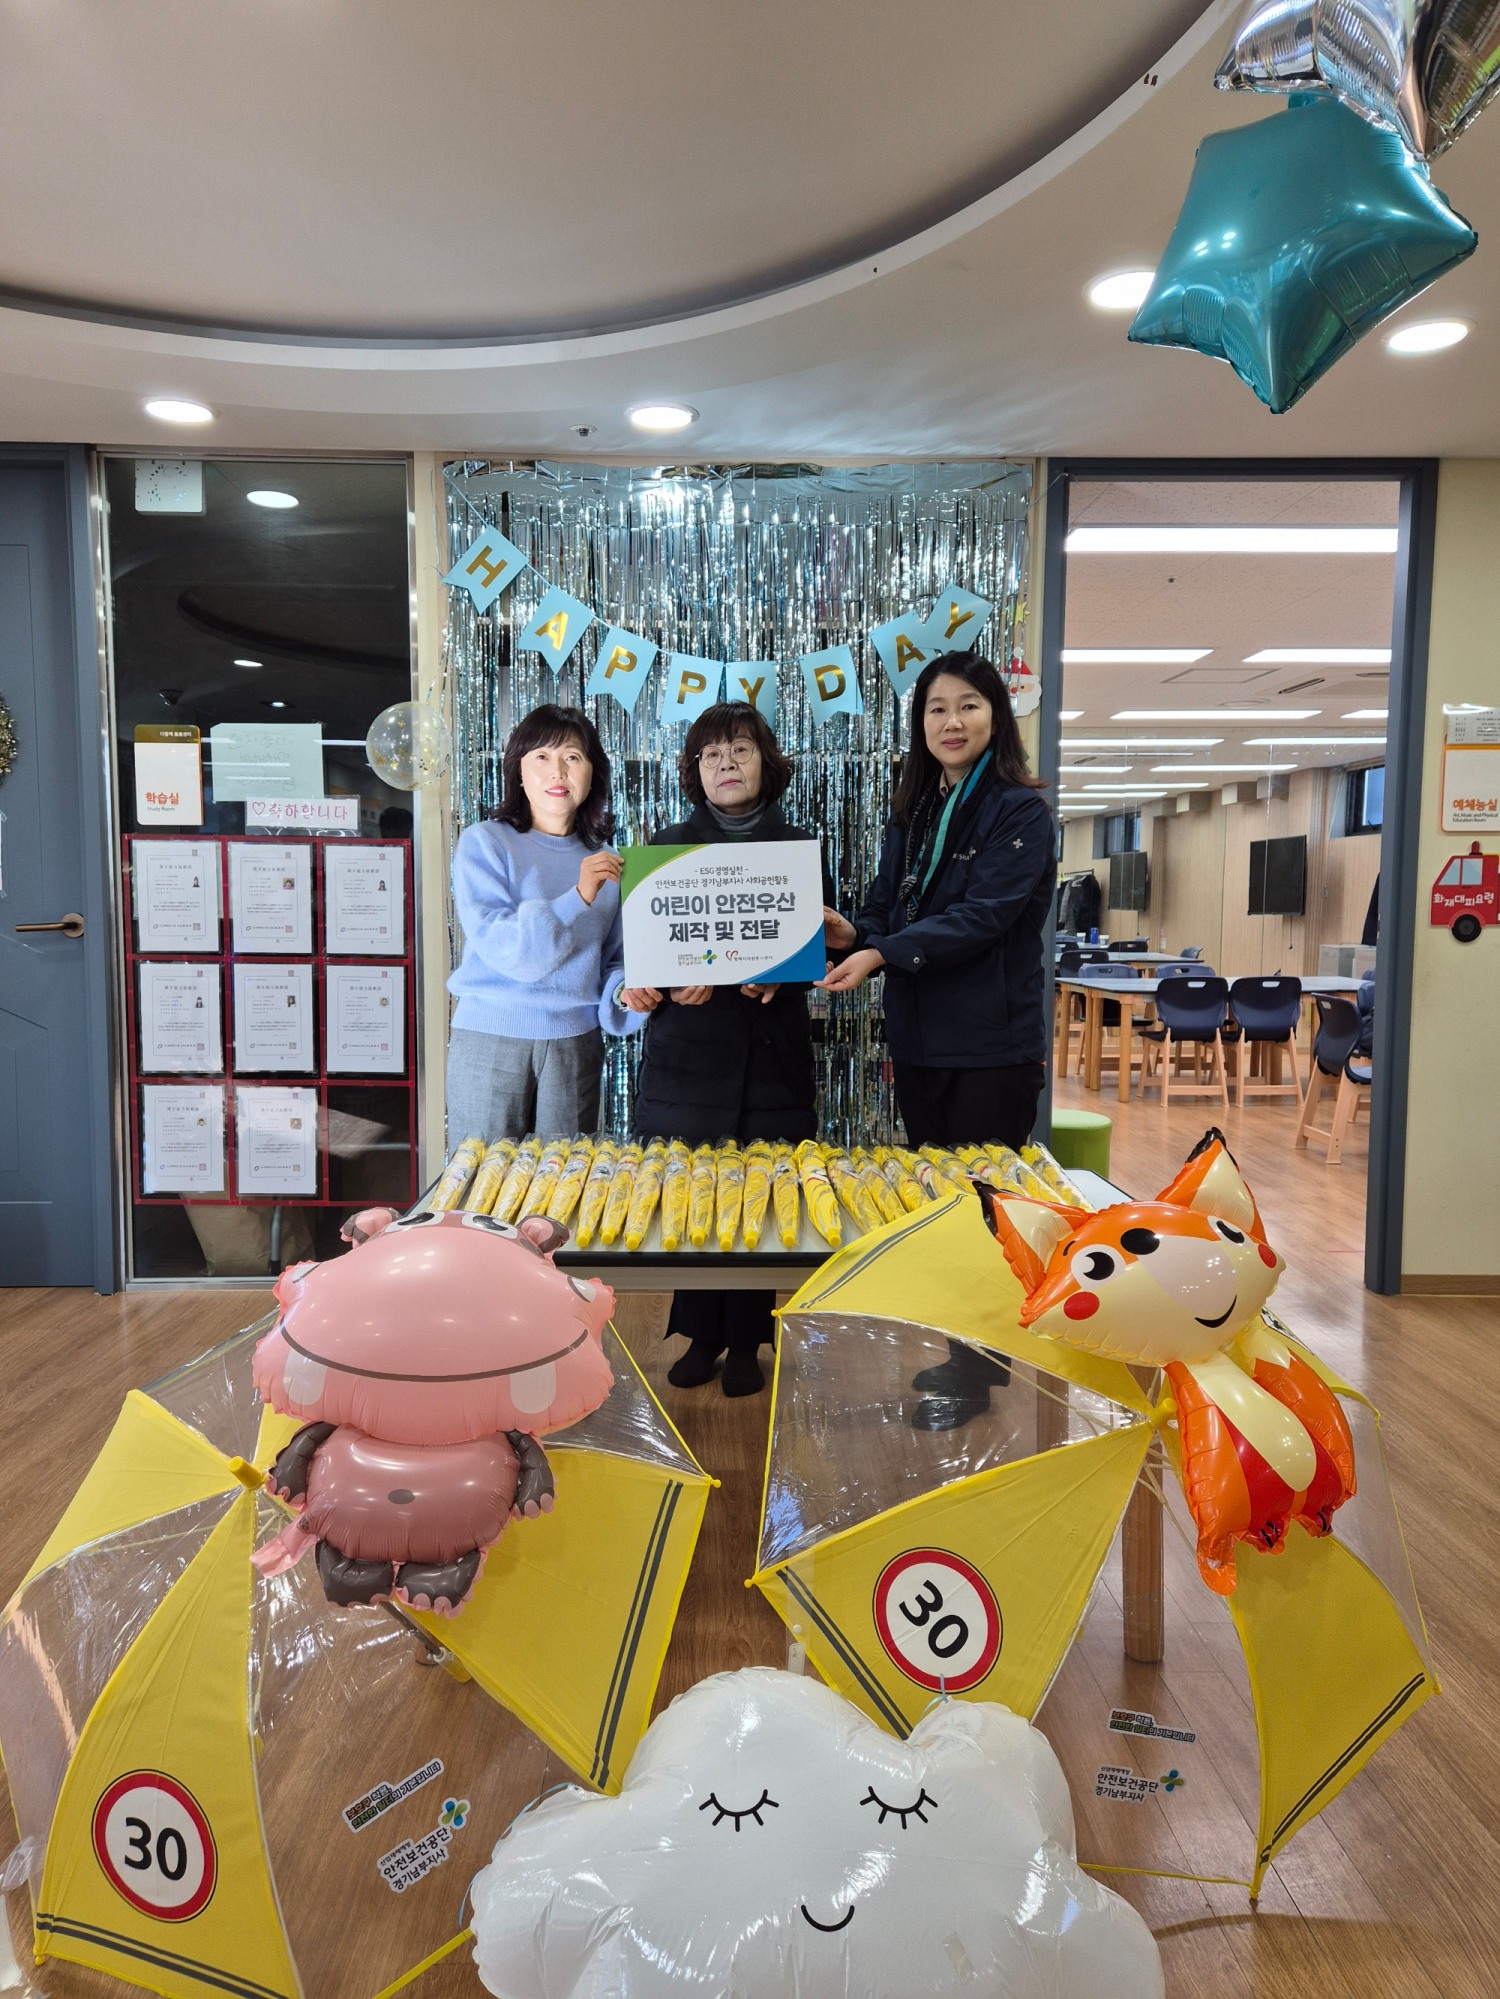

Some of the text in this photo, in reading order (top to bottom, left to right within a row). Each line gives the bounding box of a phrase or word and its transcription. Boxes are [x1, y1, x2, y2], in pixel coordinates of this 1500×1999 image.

[465, 545, 976, 708] HAPPY DAY
[145, 791, 180, 805] 학습실
[1452, 798, 1498, 811] 예체능실
[655, 875, 790, 889] 안전보건공단 경기남부지사 사회공헌활동
[650, 892, 796, 916] 어린이 안전우산
[1433, 892, 1495, 907] 화재대피요령
[669, 919, 781, 942] 제작 및 전달
[898, 1579, 969, 1659] 30
[1157, 1728, 1196, 1743] 기본입니다
[1095, 1785, 1145, 1802] 경기남부지사
[1097, 1773, 1159, 1793] 안전보건공단
[351, 1760, 442, 1830] 안전한 일터의 기본입니다
[124, 1816, 188, 1881] 30
[383, 1827, 450, 1879] 안전보건공단
[392, 1848, 446, 1890] 경기남부지사
